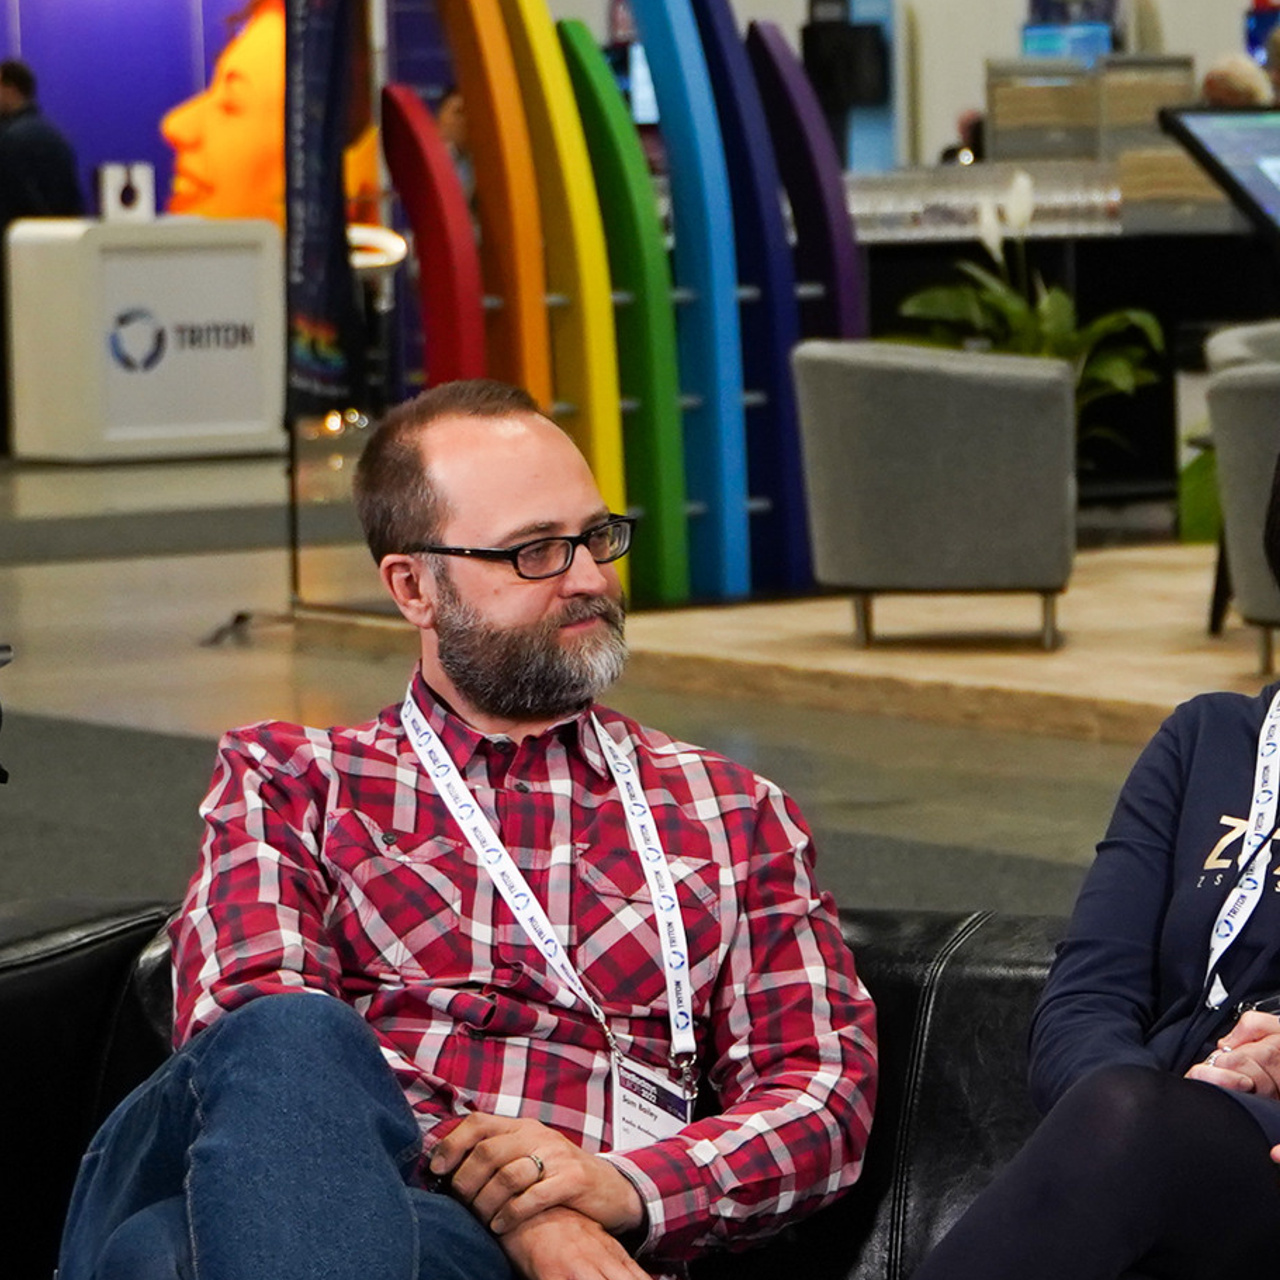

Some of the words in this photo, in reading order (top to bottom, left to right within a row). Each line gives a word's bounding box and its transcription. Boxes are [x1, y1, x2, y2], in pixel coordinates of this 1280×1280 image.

[174, 322, 254, 350] TRITON
[1227, 894, 1248, 919] TRITON
[527, 915, 546, 941] TRITON
[666, 921, 678, 948] TRITON
[674, 979, 684, 1008] TRITON
[622, 1094, 638, 1108] Sam
[638, 1103, 658, 1122] Bailey
